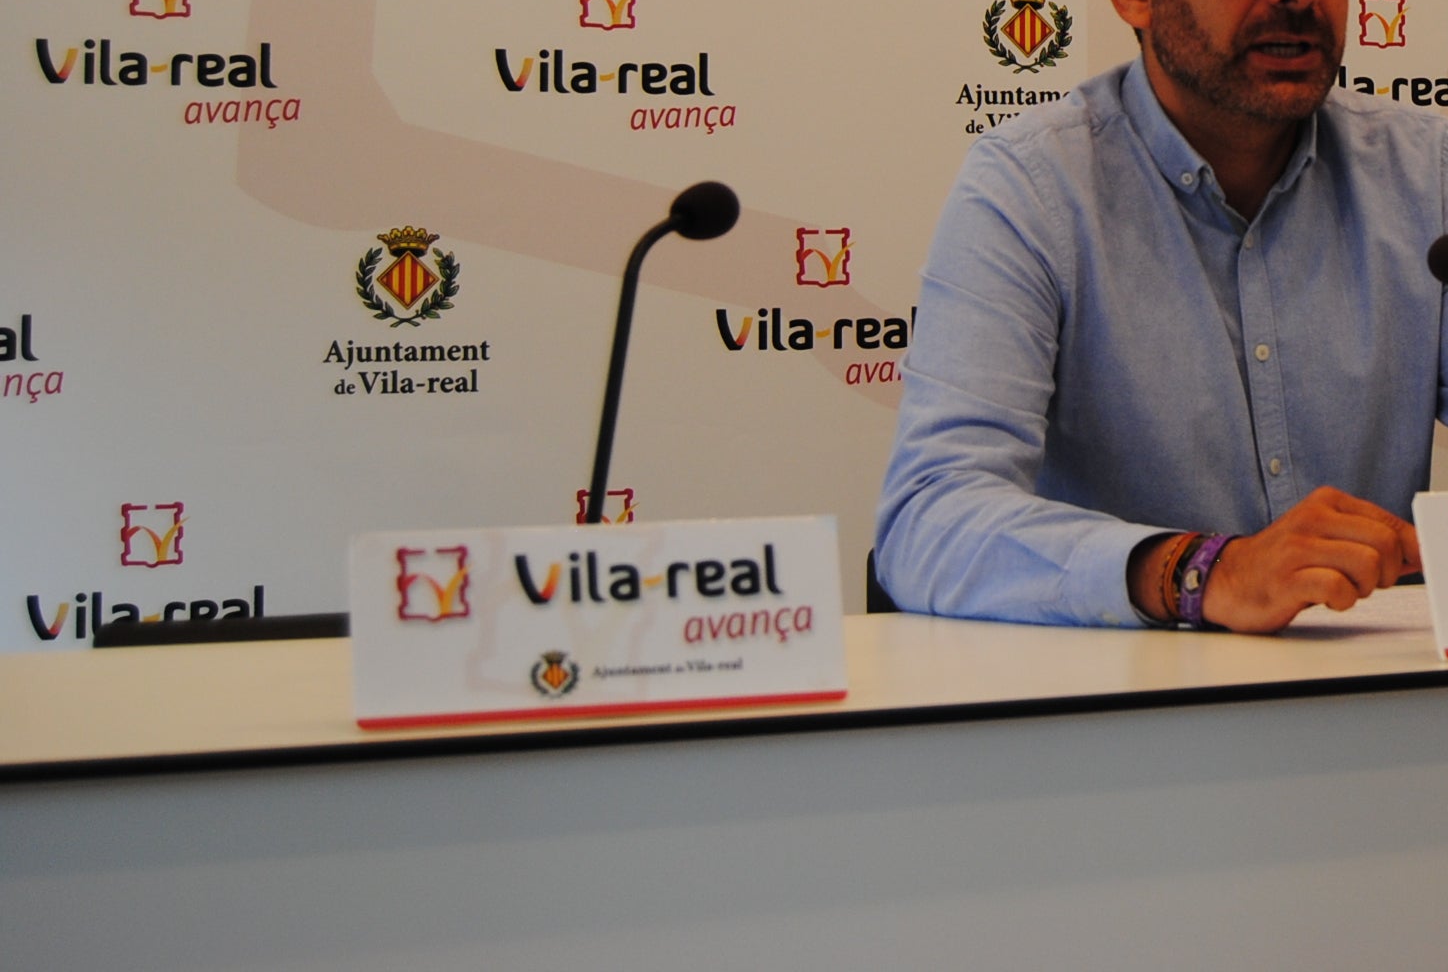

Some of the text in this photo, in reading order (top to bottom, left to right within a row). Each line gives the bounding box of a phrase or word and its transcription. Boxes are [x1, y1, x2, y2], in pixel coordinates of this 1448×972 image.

[36, 39, 277, 88] Vila-real
[495, 49, 714, 96] Vila-real
[956, 84, 1069, 111] Ajuntam
[185, 99, 300, 129] avança
[631, 106, 735, 134] avança
[966, 120, 984, 133] de
[323, 339, 490, 364] Ajuntament
[334, 369, 478, 394] de Vila-real
[846, 362, 901, 385] ava
[515, 544, 783, 606] Vila-real
[684, 607, 812, 644] avança
